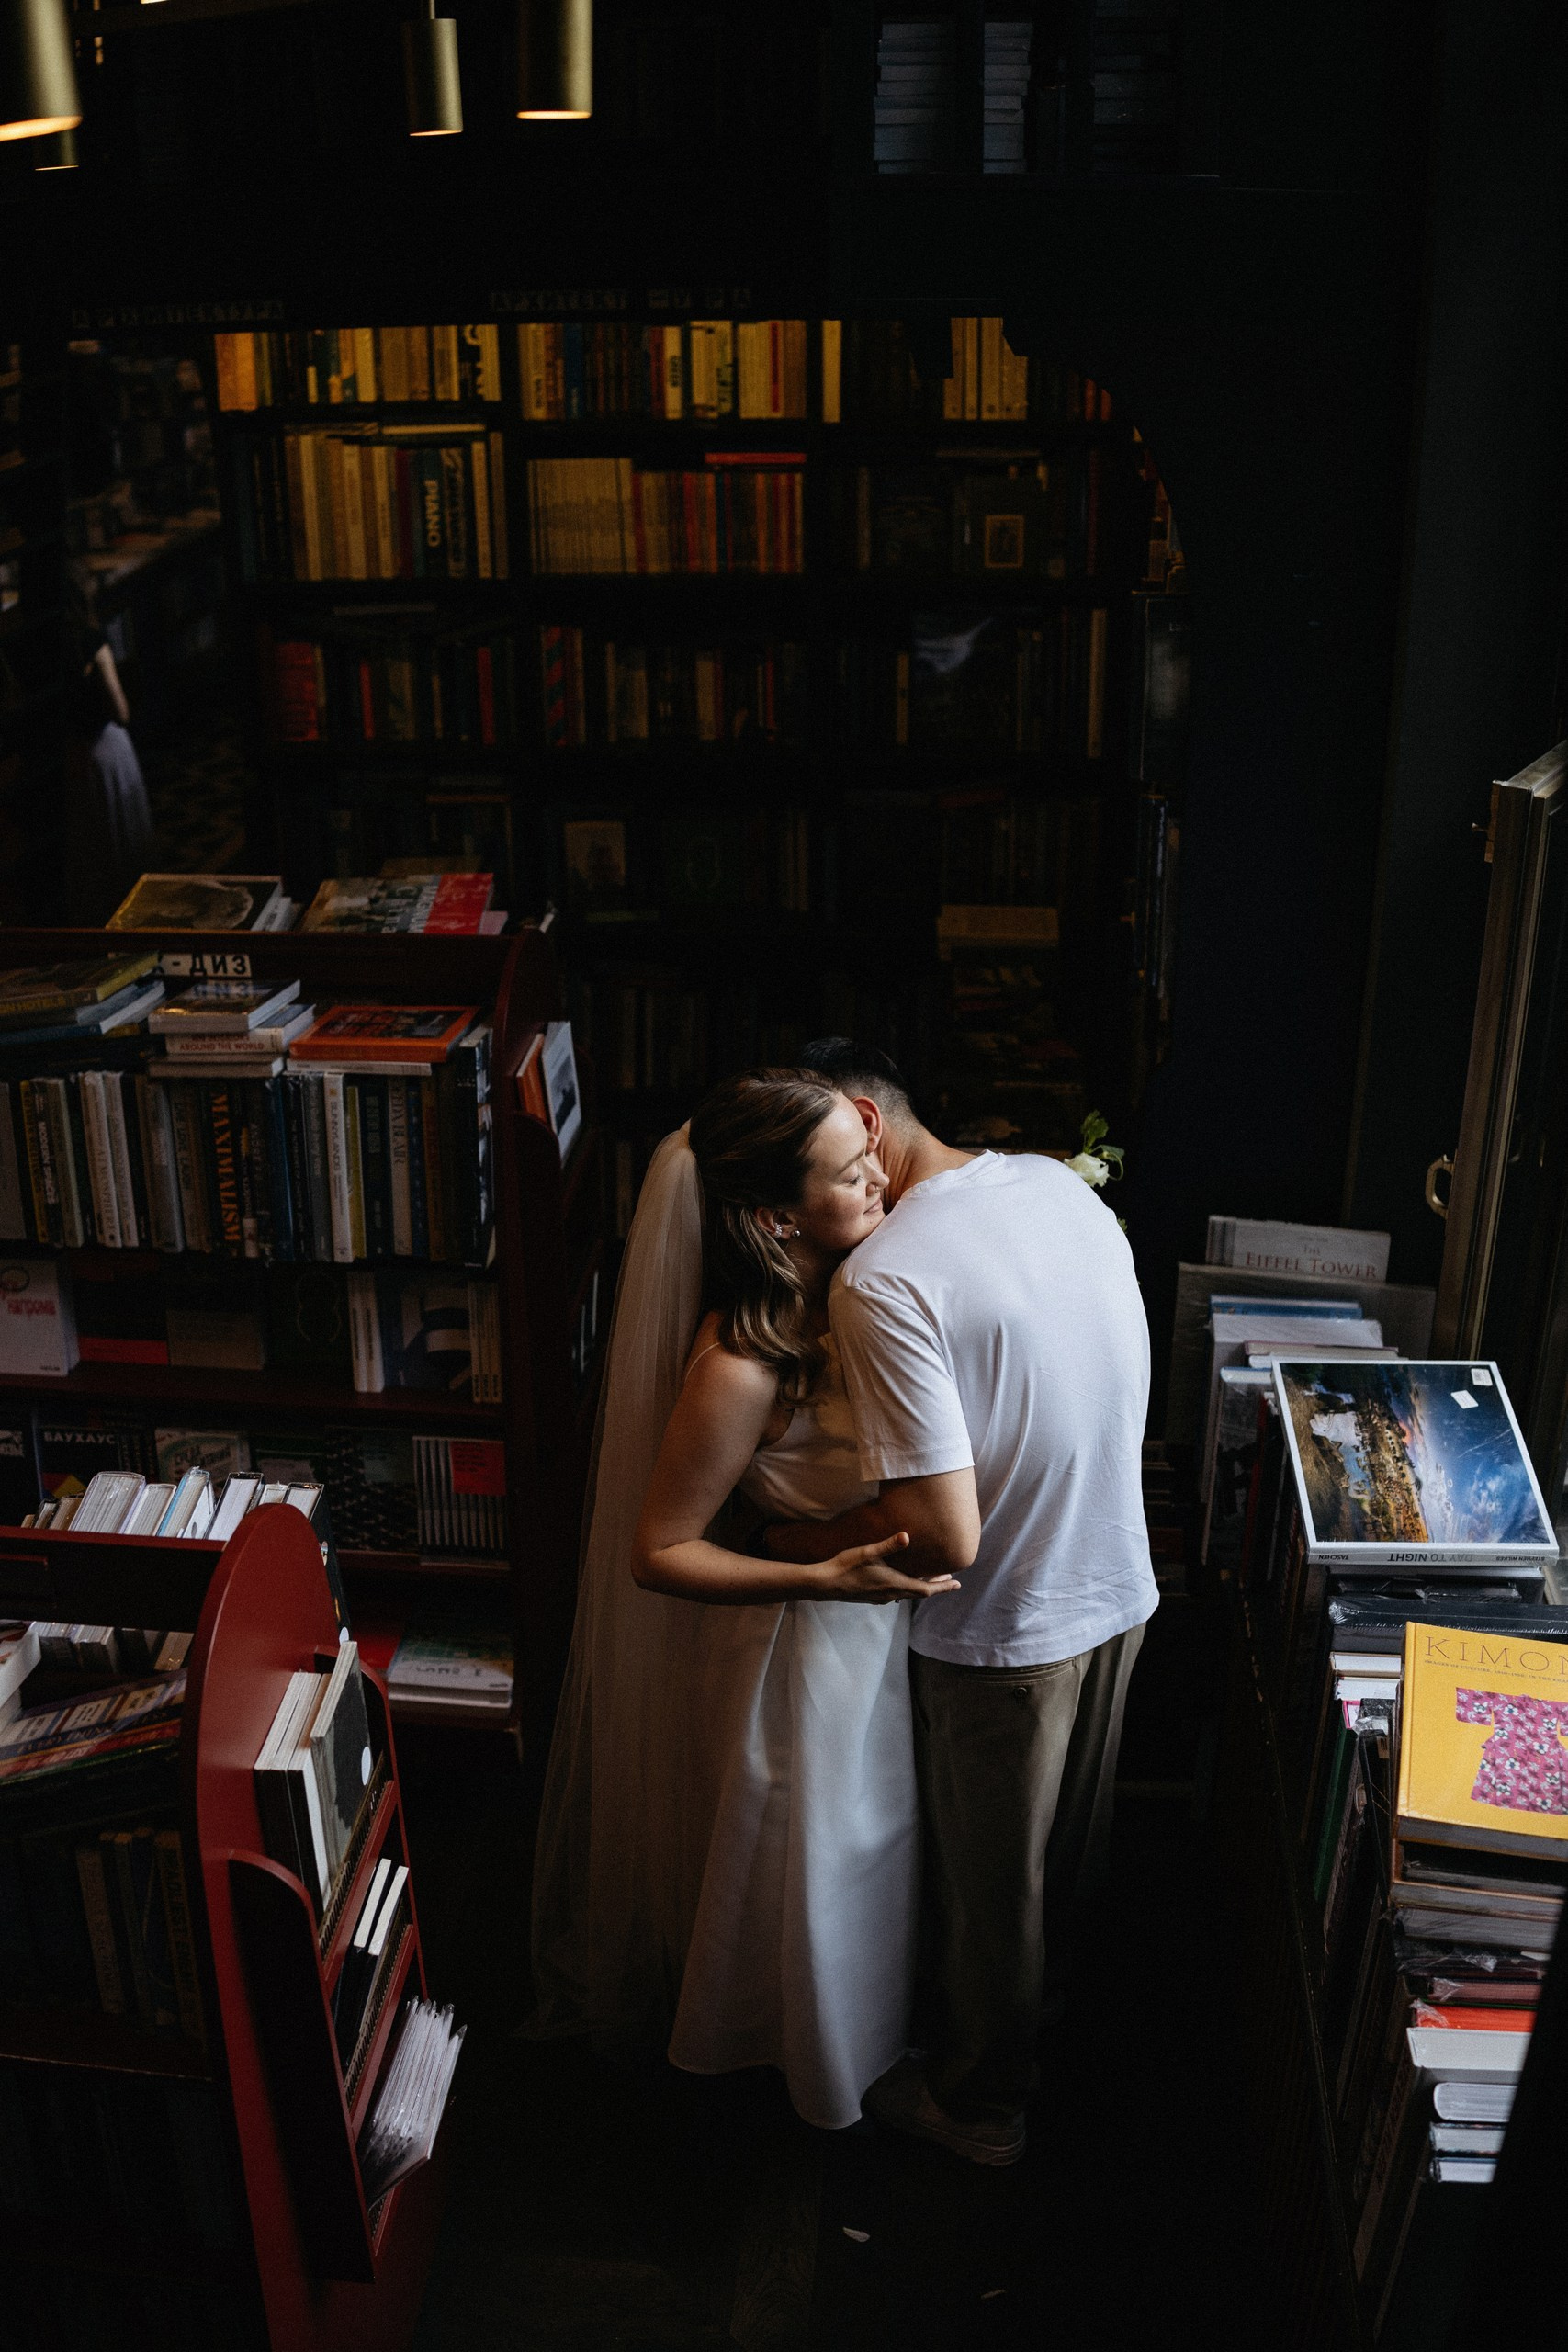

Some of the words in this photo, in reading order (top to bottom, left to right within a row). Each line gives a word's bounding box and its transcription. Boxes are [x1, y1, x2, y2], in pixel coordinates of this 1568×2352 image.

[424, 479, 440, 548] PIANO
[180, 1042, 215, 1051] AROUND
[218, 1042, 232, 1050] THE
[235, 1042, 265, 1050] WORLD
[330, 1101, 340, 1171] SUNNYLANDS
[392, 1125, 406, 1164] BLAIR
[211, 1093, 240, 1241] MAXIMALISM
[1246, 1251, 1299, 1271] EIFFEL
[1310, 1258, 1377, 1278] TOWER
[43, 1430, 116, 1445] БАУХАУС
[1388, 1553, 1427, 1563] NIGHT
[1430, 1553, 1445, 1562] TO
[1449, 1553, 1472, 1562] DAY
